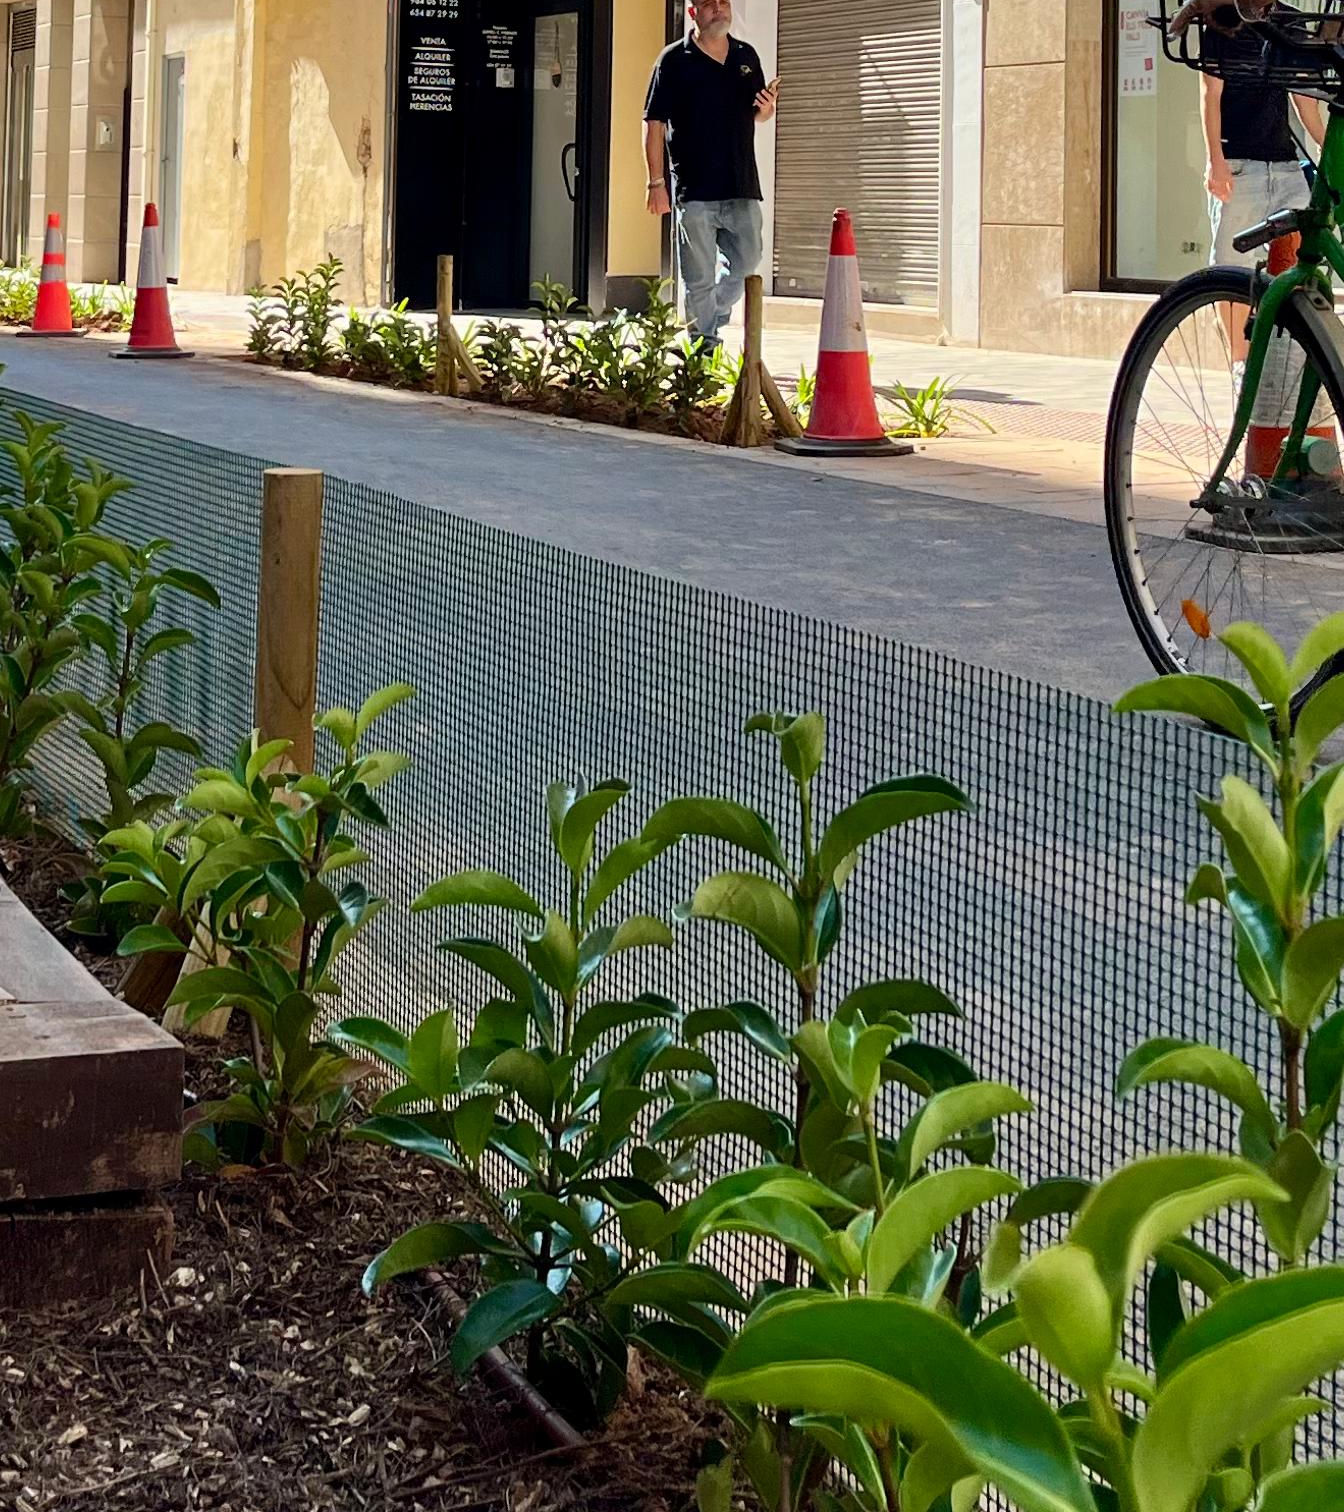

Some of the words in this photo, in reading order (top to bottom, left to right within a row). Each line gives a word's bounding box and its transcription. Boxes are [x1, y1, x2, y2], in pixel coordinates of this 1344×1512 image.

[420, 37, 447, 46] VENTA
[414, 52, 451, 62] ALQUILER
[413, 67, 451, 76] SEGUROS
[408, 76, 418, 85] DE
[419, 76, 456, 86] ALQUILER
[411, 92, 452, 102] TASACIÓN
[409, 102, 453, 112] HERENCIAS
